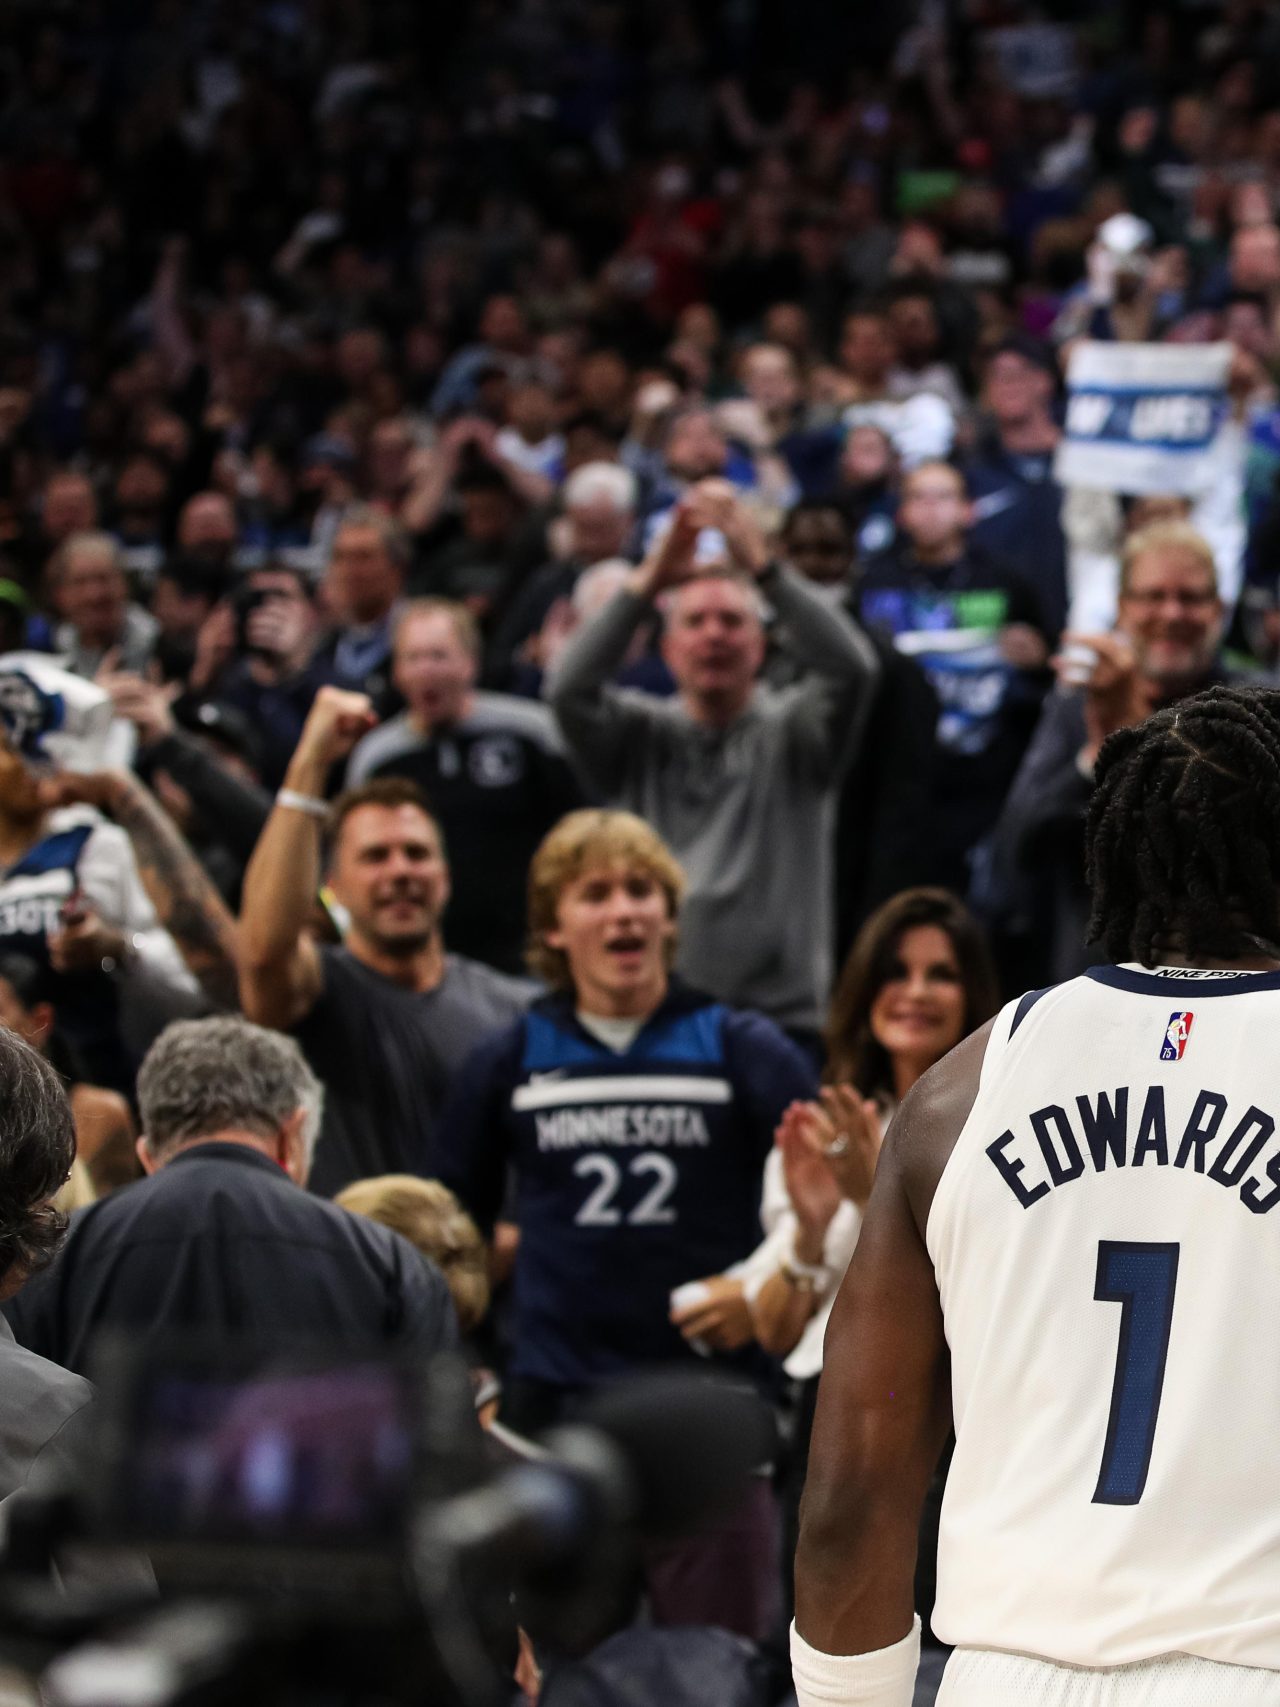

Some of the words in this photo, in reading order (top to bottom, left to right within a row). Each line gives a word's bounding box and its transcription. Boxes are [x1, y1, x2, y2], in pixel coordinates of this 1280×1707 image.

[1155, 969, 1203, 978] NIKE
[1162, 1047, 1172, 1058] 75
[534, 1105, 711, 1152] MINNESOTA
[573, 1153, 678, 1226] 22
[1090, 1239, 1181, 1506] 1
